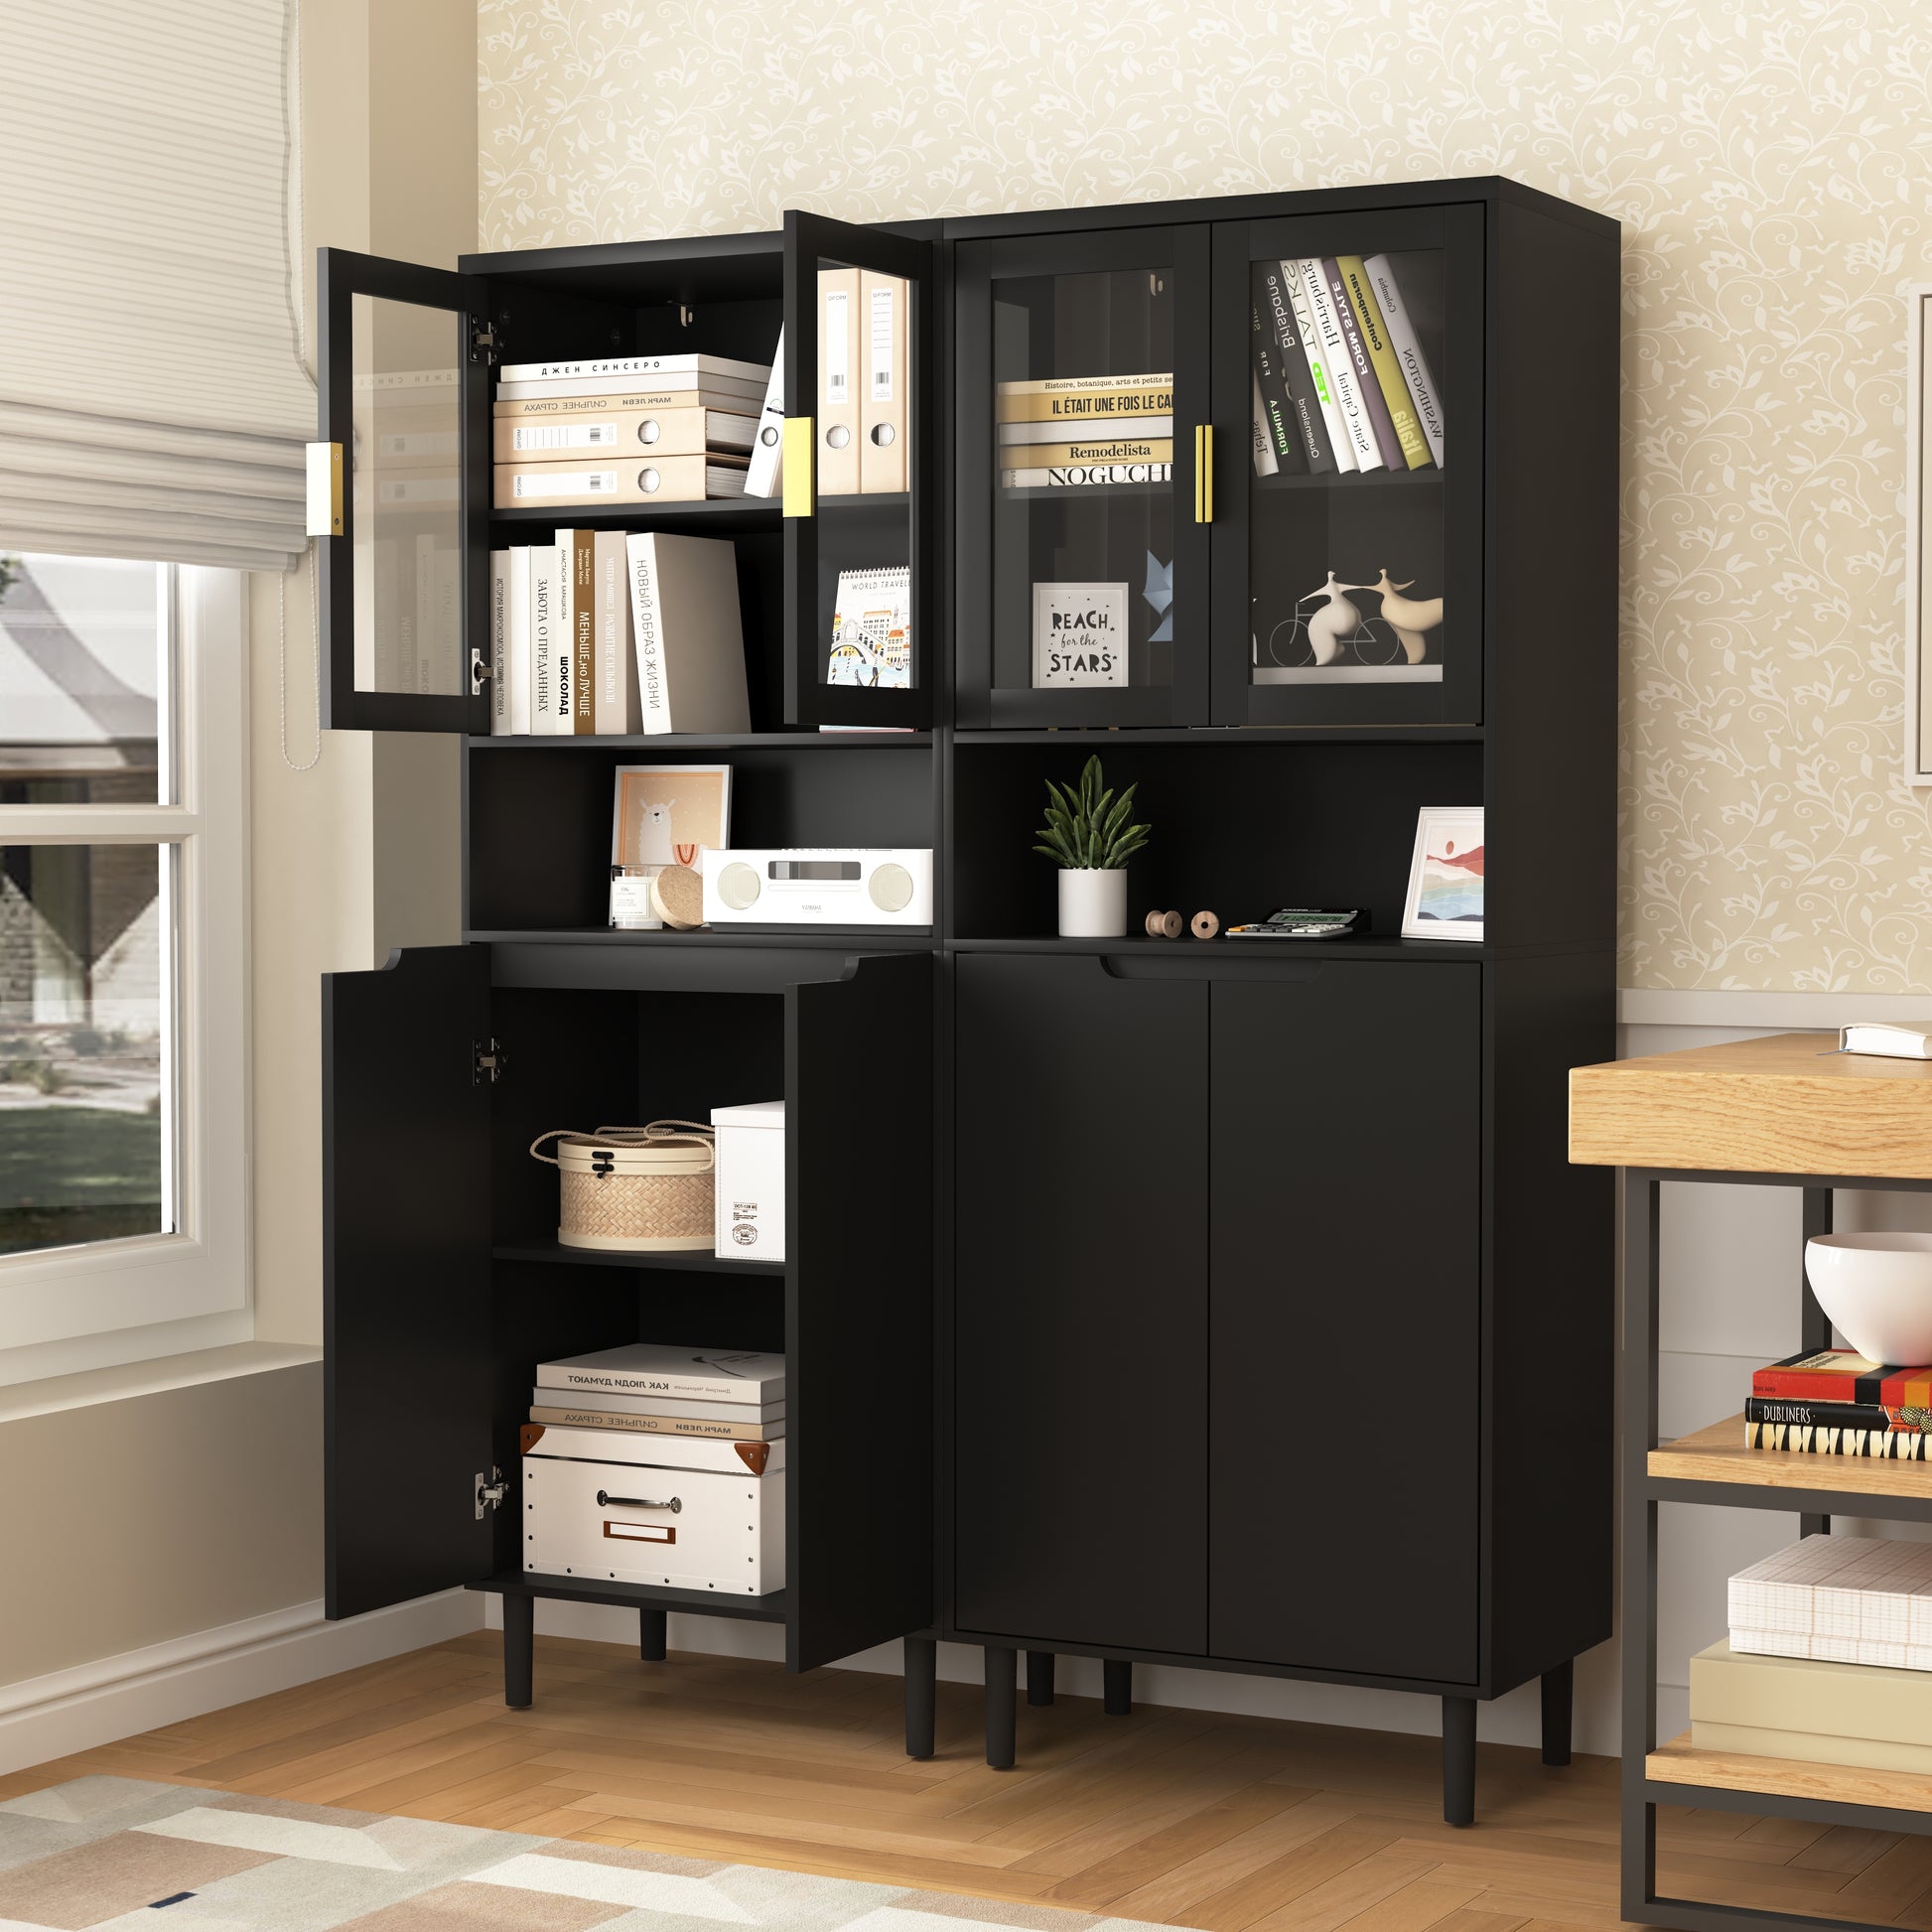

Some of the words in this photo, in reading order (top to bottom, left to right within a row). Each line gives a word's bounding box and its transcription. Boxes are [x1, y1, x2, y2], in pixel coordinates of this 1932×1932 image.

[542, 365, 580, 375] ДЖЕН
[592, 361, 660, 371] СИНСЕРО
[1077, 379, 1114, 388] botanique,
[1142, 376, 1163, 385] petits
[1052, 399, 1062, 415] IL
[1064, 397, 1092, 414] ÉTAIT
[1094, 397, 1115, 413] UNE
[1118, 395, 1140, 411] FOIS
[1142, 395, 1155, 410] LE
[1069, 444, 1152, 459] Remodelista
[636, 560, 653, 609] НОВЫЙ
[538, 578, 548, 621] ЗАБОТА
[1052, 610, 1108, 629] REACH
[538, 626, 548, 635] О
[641, 613, 655, 655] ОБРАЗ
[1060, 633, 1078, 648] for
[1080, 633, 1098, 645] the
[1050, 653, 1112, 673] STARS
[537, 638, 548, 712] ПРЕДАННЫХ
[645, 659, 660, 709] ЖИЗНИ
[559, 656, 568, 716] ШОКОЛАД
[579, 677, 590, 717] ЛУЧШЕ
[1763, 1405, 1811, 1424] DUBLINERS
